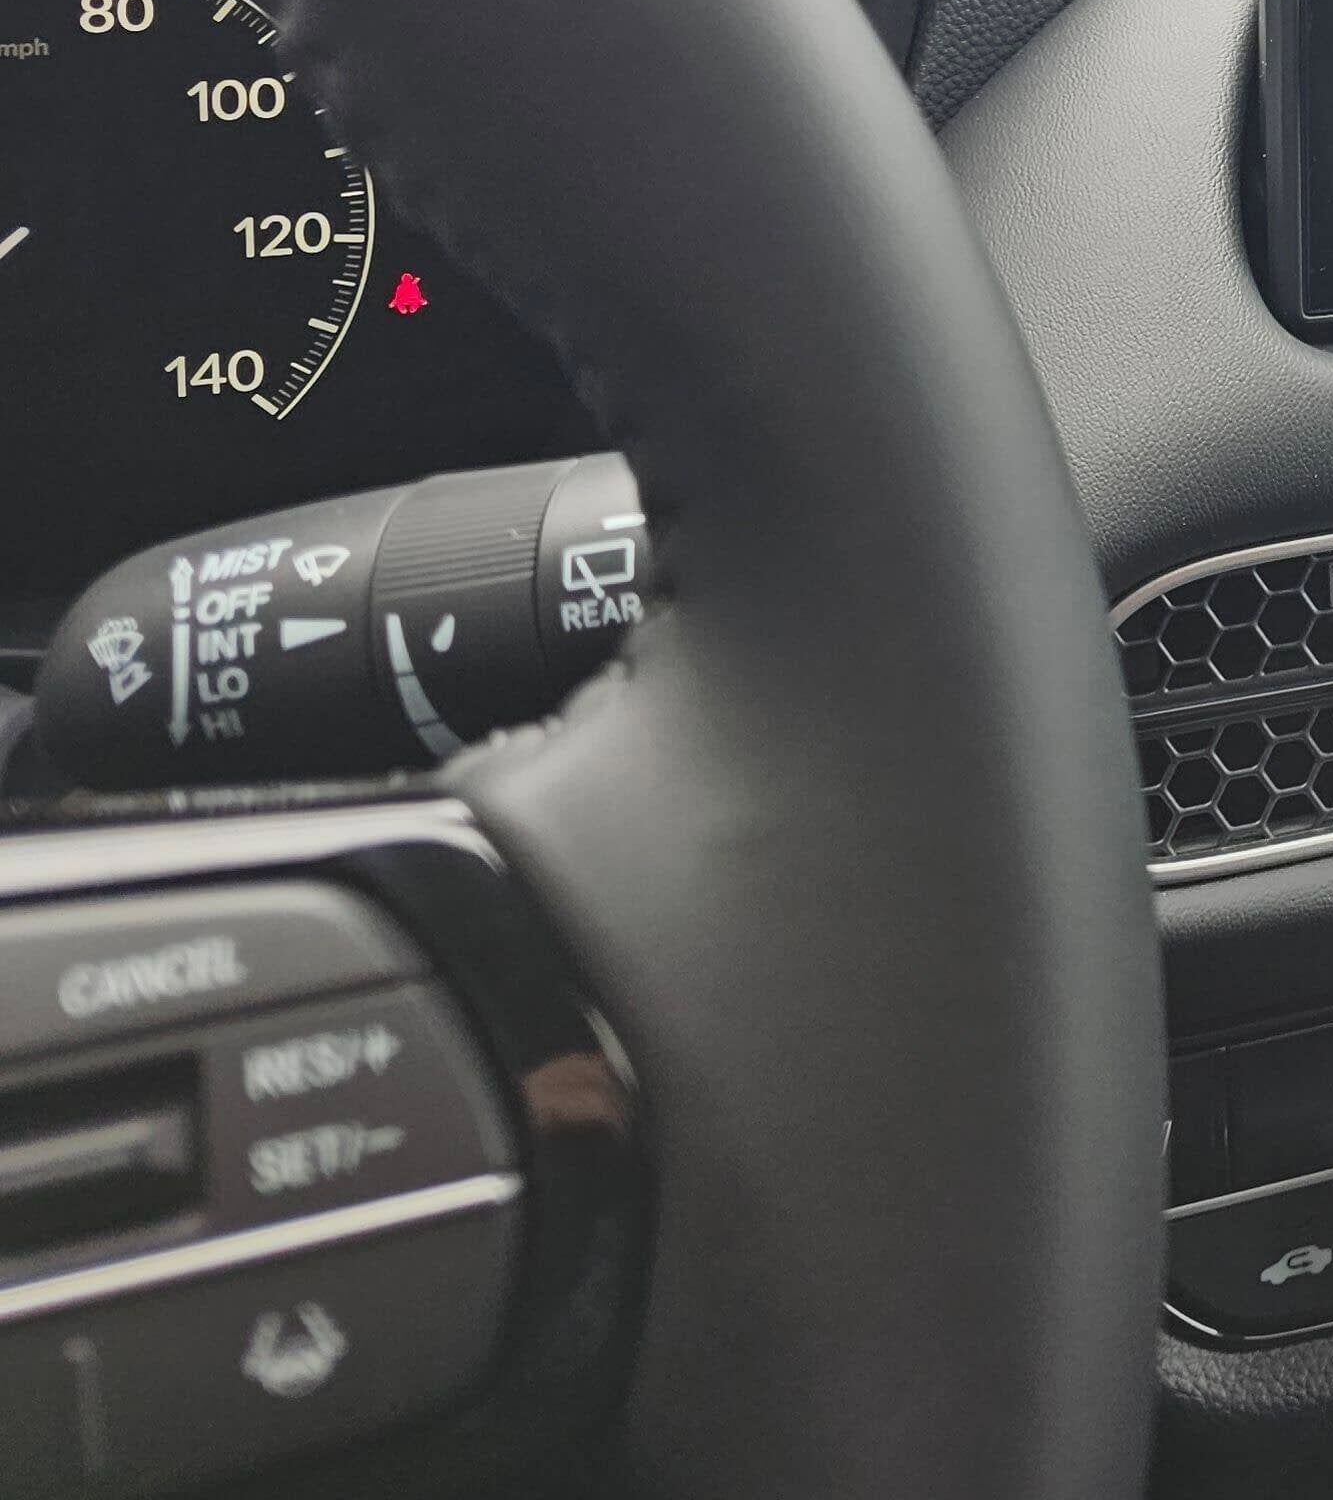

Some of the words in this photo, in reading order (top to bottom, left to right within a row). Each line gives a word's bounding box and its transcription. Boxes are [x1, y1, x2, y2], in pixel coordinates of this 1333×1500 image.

[0, 38, 49, 60] mph
[186, 76, 286, 122] 100
[233, 211, 331, 258] 120
[164, 349, 265, 398] 140
[199, 538, 293, 584] MIST
[196, 581, 273, 625] OFF
[560, 592, 644, 632] REAR
[197, 622, 262, 665] INT
[197, 667, 249, 703] LO
